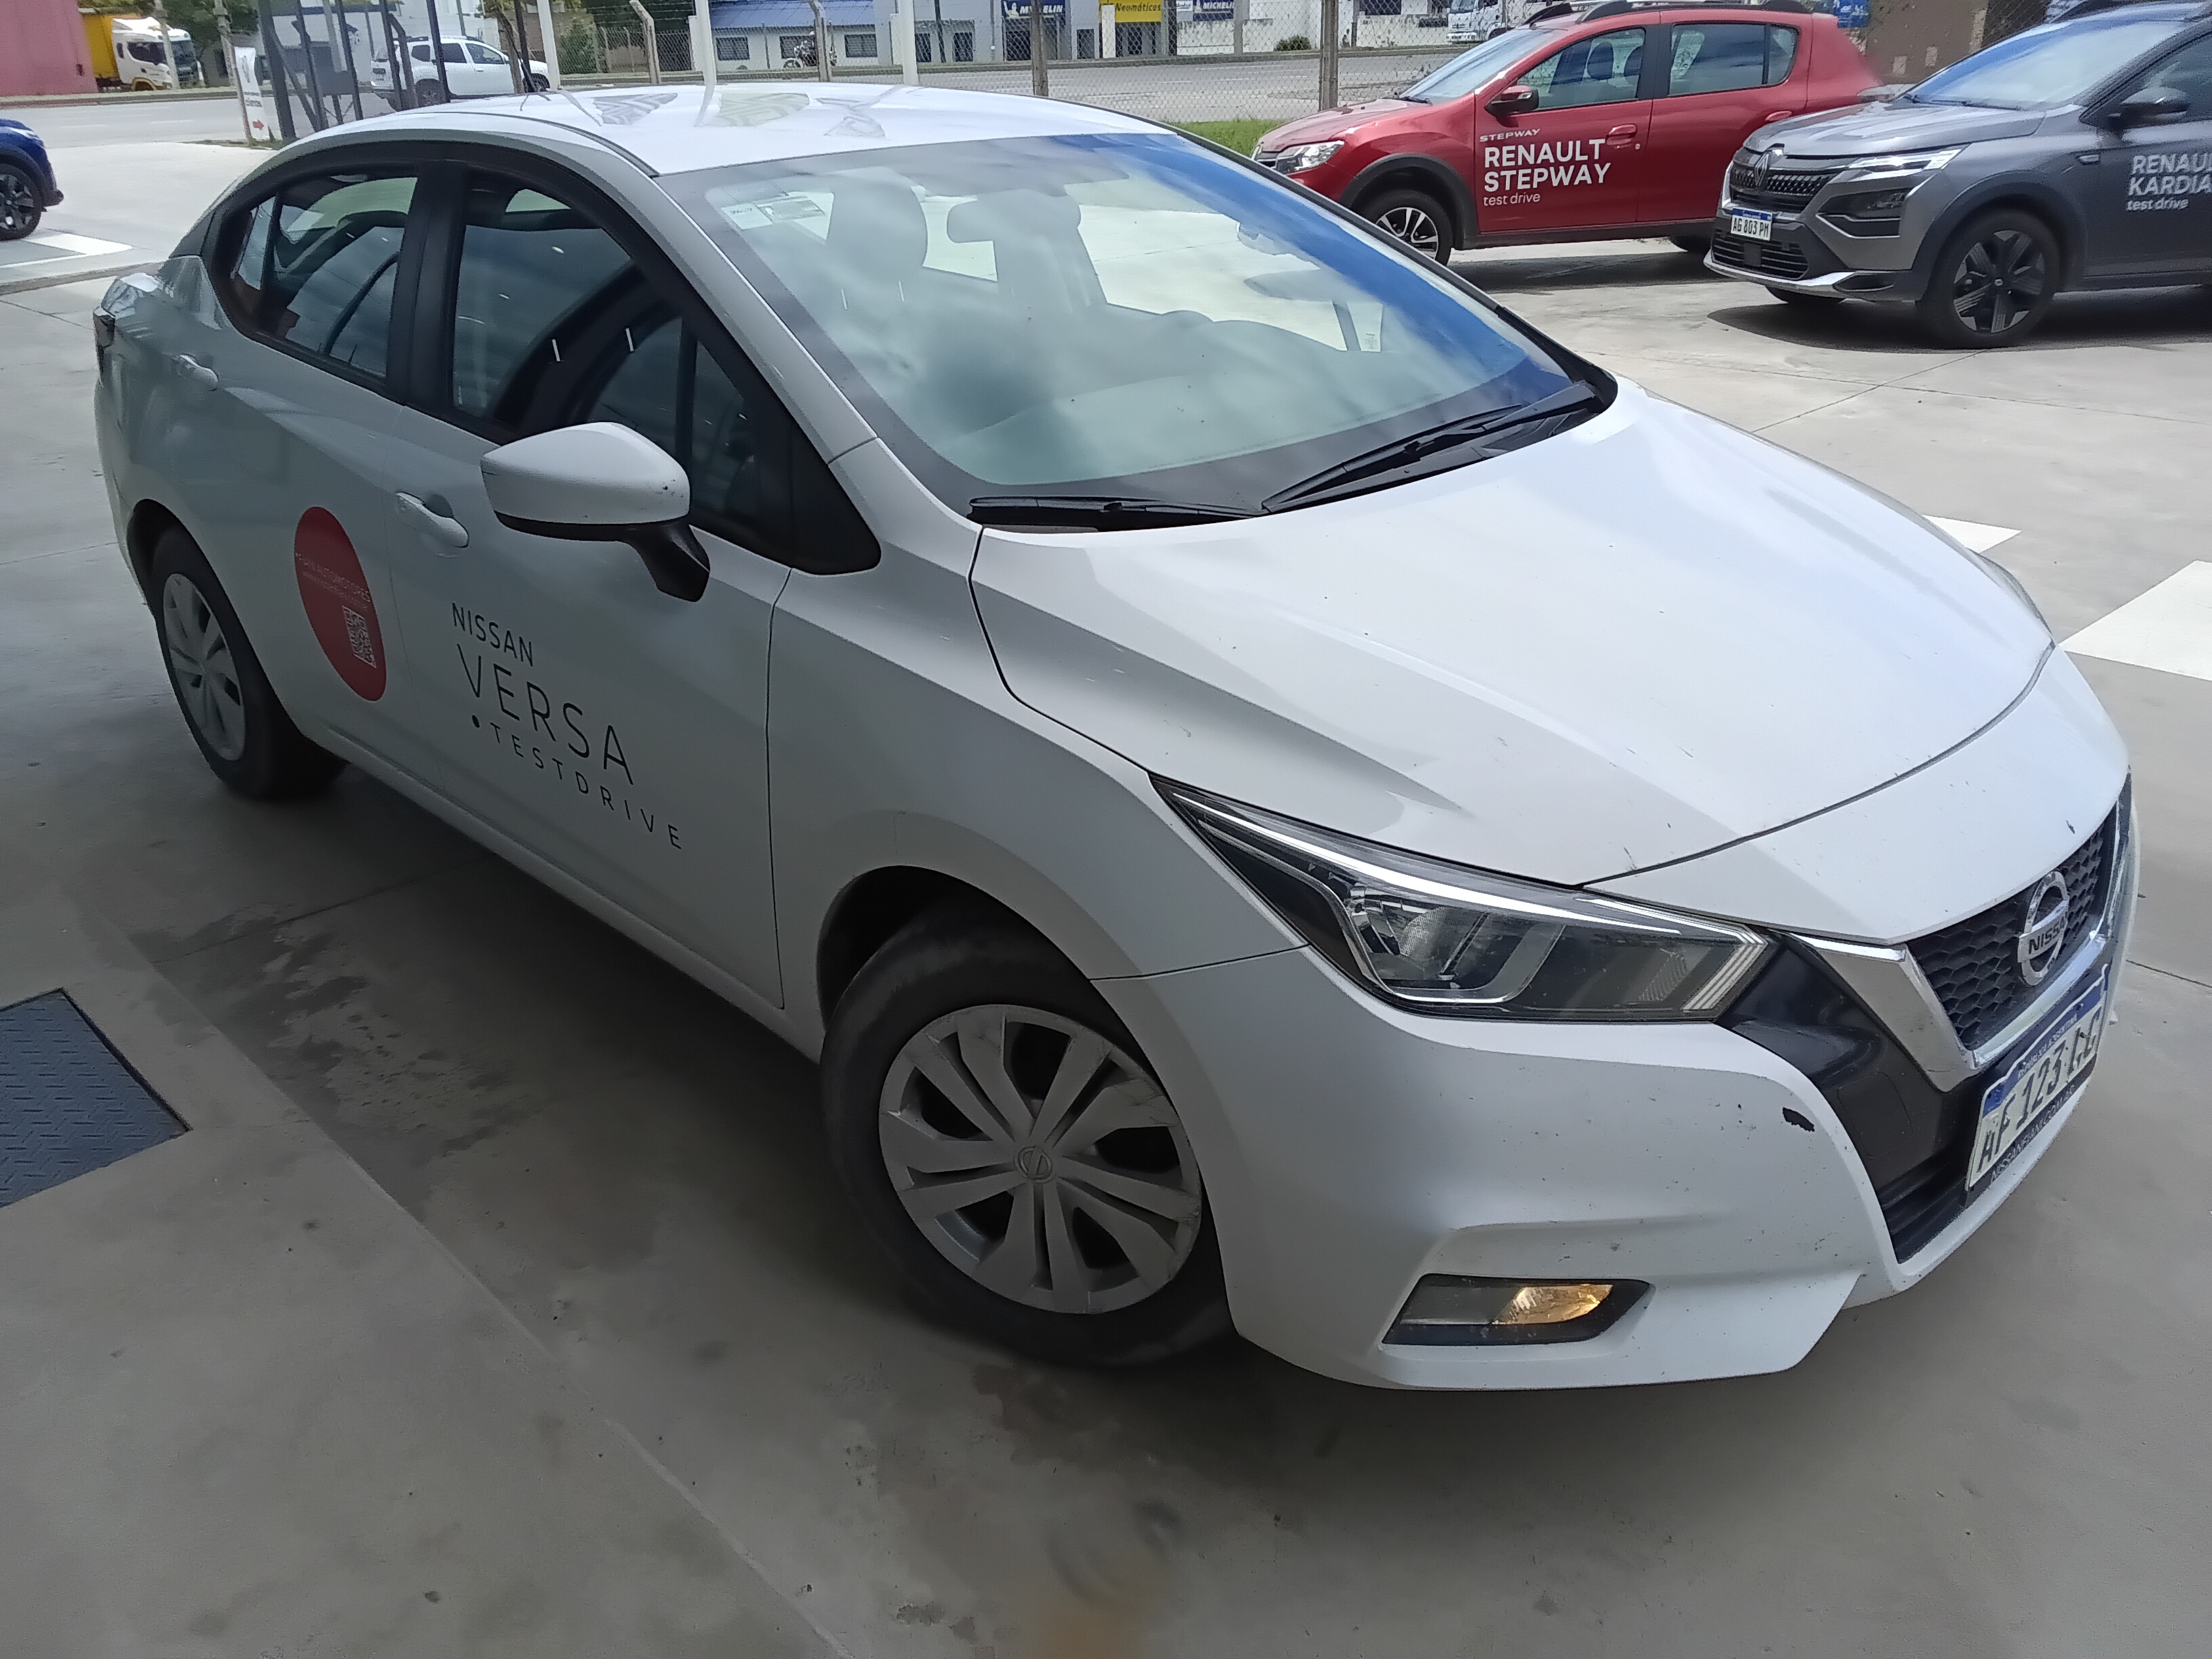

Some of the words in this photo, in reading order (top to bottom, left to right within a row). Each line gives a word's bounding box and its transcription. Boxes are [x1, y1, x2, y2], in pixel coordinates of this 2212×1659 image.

[1020, 5, 1063, 14] MIELIN
[1115, 2, 1161, 12] Neumáticos
[1479, 129, 1540, 142] STEPWAY
[1485, 139, 1605, 167] RENAULT
[1484, 163, 1611, 192] STEPWAY
[1483, 194, 1507, 206] test
[1510, 192, 1540, 204] drive
[2127, 199, 2154, 210] test
[2155, 197, 2188, 209] drive
[1733, 218, 1742, 232] AG
[1744, 220, 1757, 234] 803
[452, 602, 533, 667] NISSAN
[457, 643, 634, 785] VERSA
[1976, 1093, 2015, 1172] AF
[2016, 1040, 2066, 1130] 123
